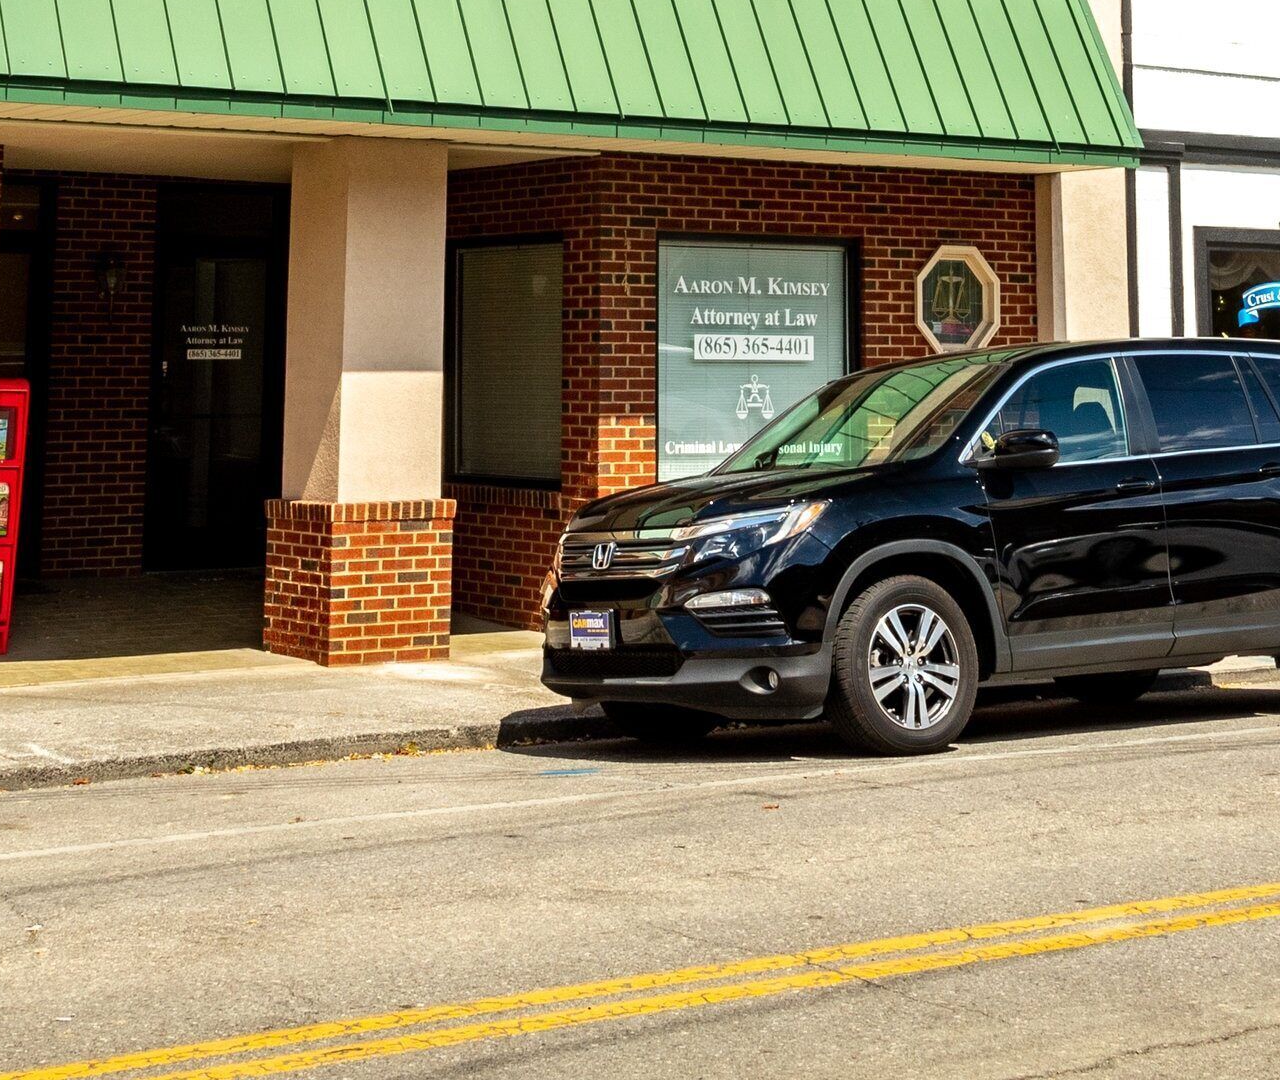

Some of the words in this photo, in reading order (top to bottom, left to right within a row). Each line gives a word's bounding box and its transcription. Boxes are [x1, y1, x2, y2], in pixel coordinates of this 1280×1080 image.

[673, 275, 733, 294] AARON
[738, 276, 762, 295] M.
[768, 277, 830, 297] KIMSEY
[1247, 290, 1275, 307] Crust
[690, 306, 761, 330] Attorney
[765, 310, 780, 326] at
[785, 309, 818, 326] Law
[186, 337, 217, 346] Attorney
[698, 336, 738, 358] (865)
[742, 338, 810, 355] 365-4401
[665, 440, 716, 454] Criminal
[808, 441, 843, 456] Injury
